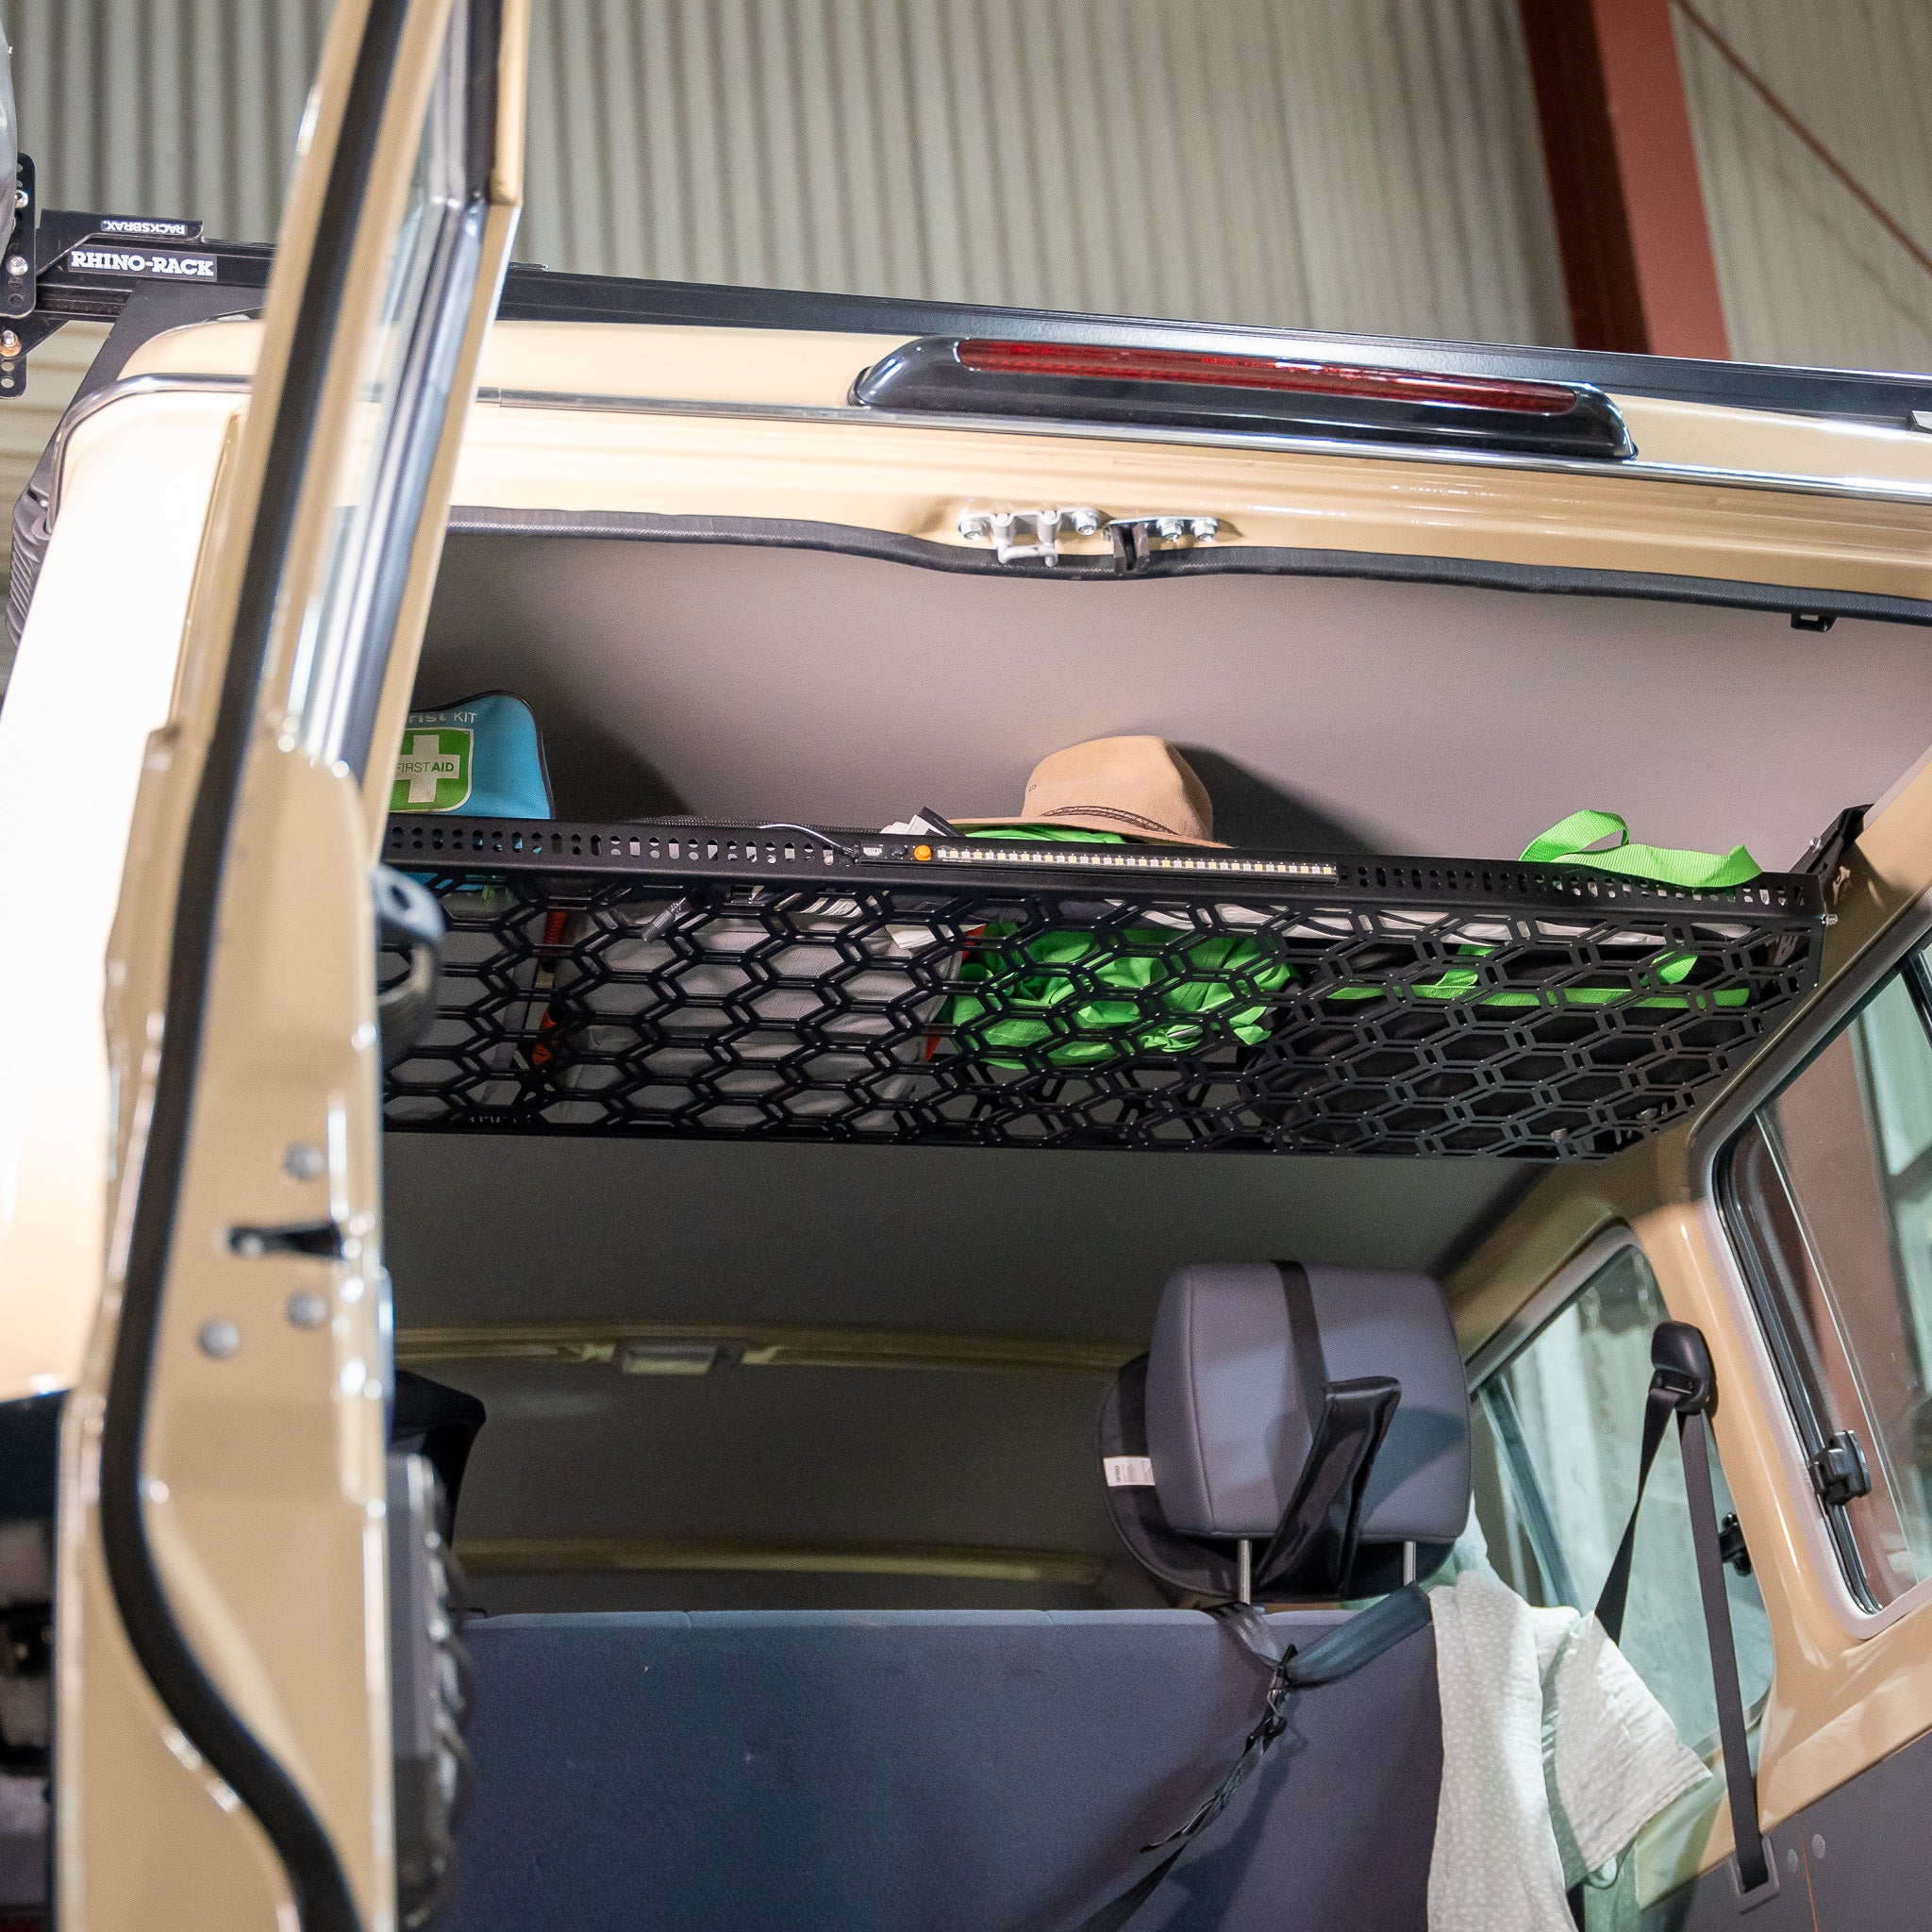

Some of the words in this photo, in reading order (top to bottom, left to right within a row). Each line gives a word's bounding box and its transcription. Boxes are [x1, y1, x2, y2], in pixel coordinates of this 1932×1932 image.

[71, 251, 214, 276] RHINO-RACK
[408, 711, 447, 724] rist
[454, 710, 477, 724] KIT
[431, 761, 455, 773] AID
